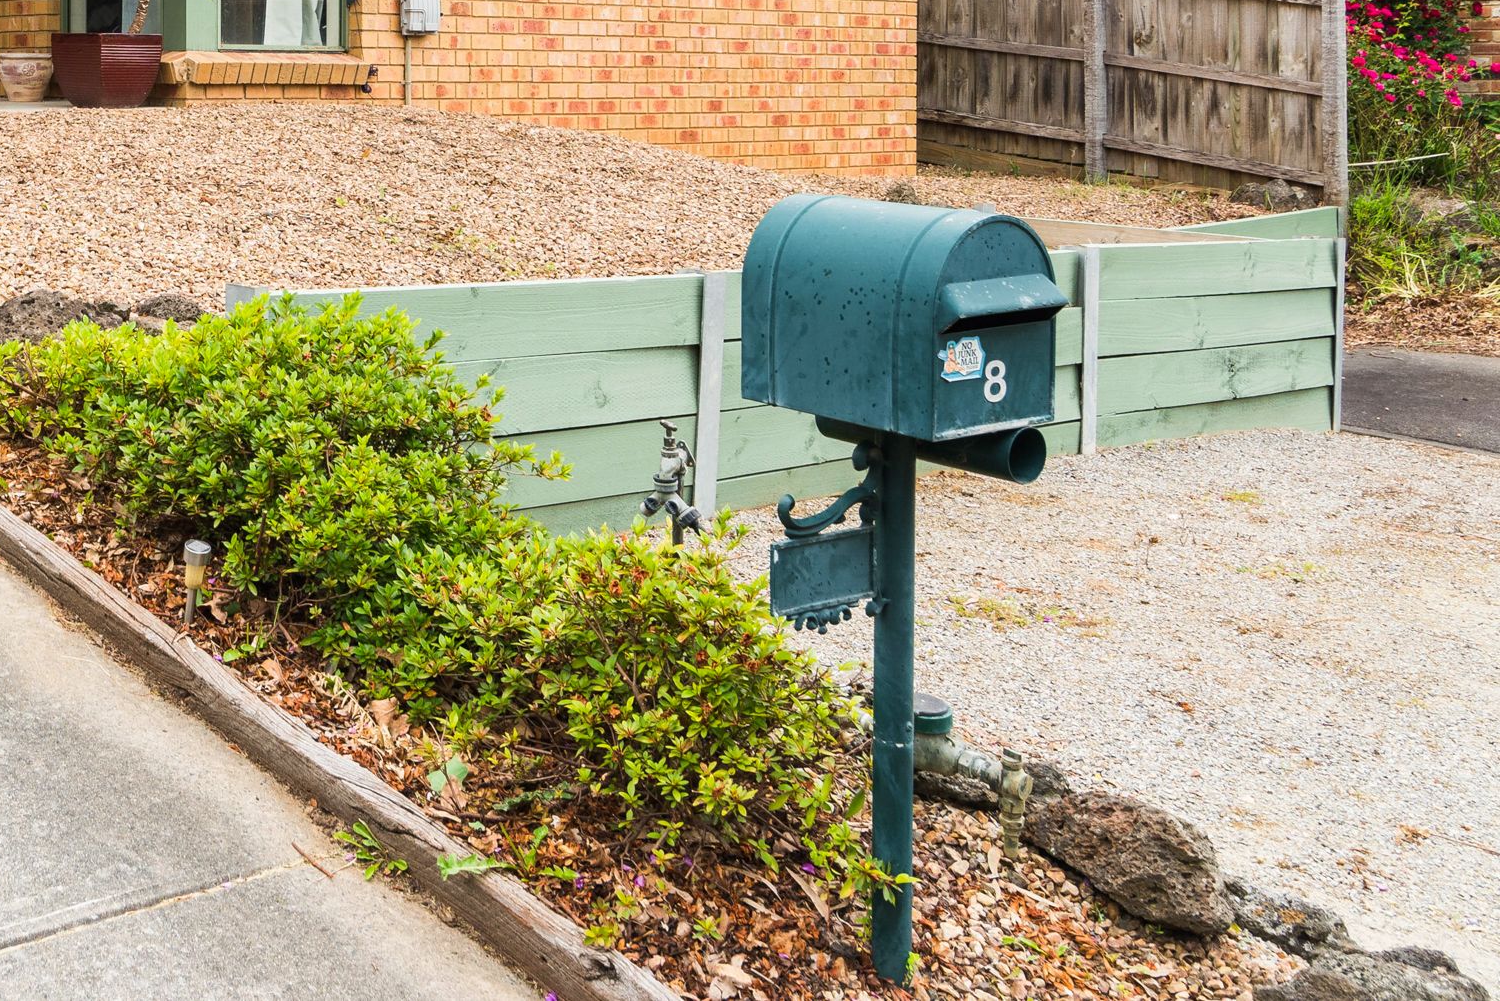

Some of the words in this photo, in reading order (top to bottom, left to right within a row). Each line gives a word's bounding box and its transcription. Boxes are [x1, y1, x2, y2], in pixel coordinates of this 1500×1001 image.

[961, 341, 973, 350] NO
[958, 349, 977, 359] JUNK
[960, 357, 979, 366] MAIL
[984, 359, 1007, 402] 8
